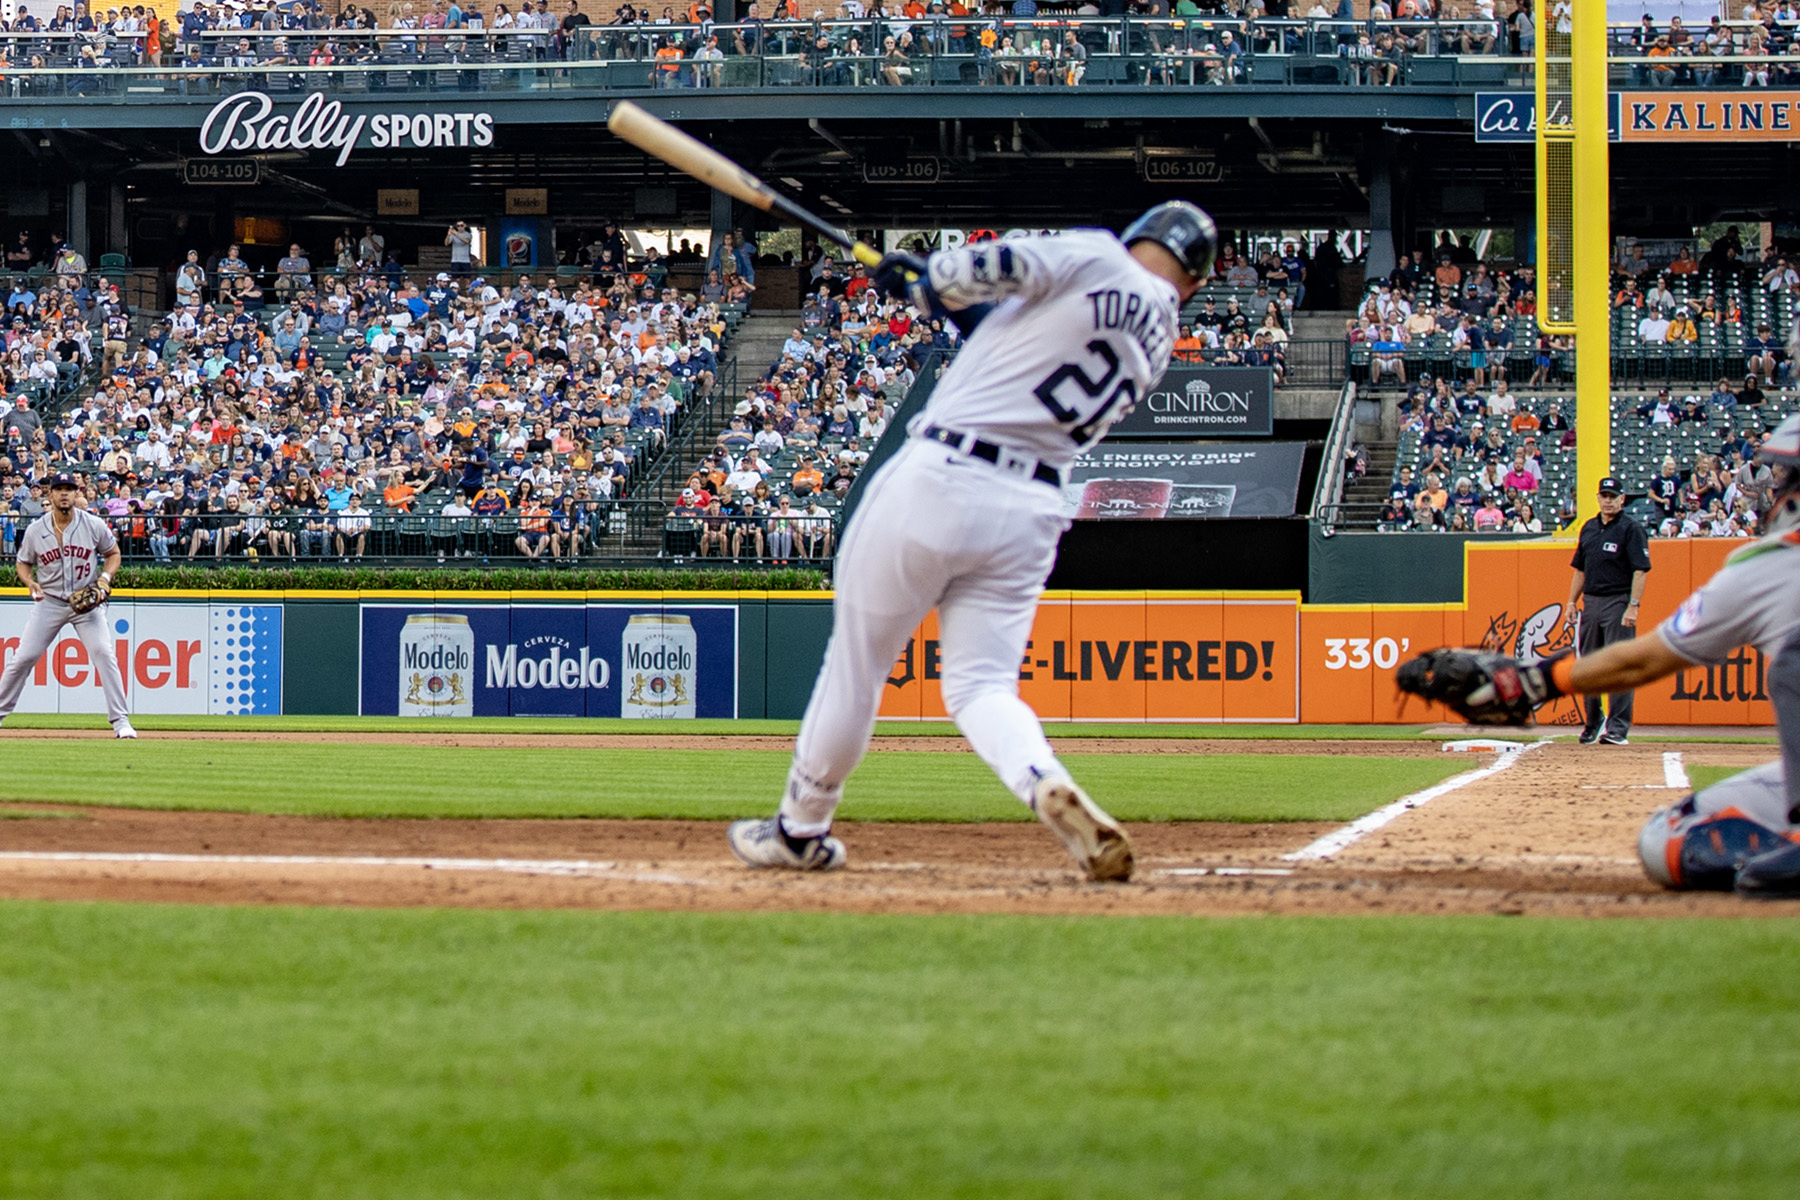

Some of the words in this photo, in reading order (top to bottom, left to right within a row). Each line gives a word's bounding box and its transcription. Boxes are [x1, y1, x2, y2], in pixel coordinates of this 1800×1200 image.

[199, 91, 368, 168] Bally
[371, 112, 495, 148] SPORTS
[1147, 391, 1251, 413] CINTRON
[1153, 415, 1248, 425] DRINKCINTRON.COM
[1103, 453, 1186, 462] ENERGY
[1191, 452, 1257, 461] DRINK
[1169, 458, 1242, 468] TIGERS
[40, 545, 92, 567] HOUSTON
[75, 562, 91, 581] 79
[523, 636, 571, 649] CERVEZA
[1324, 636, 1411, 671] 330'
[404, 643, 469, 670] Modelo
[485, 644, 611, 690] Modelo
[627, 643, 692, 671] Modelo
[1669, 645, 1769, 702] Littl
